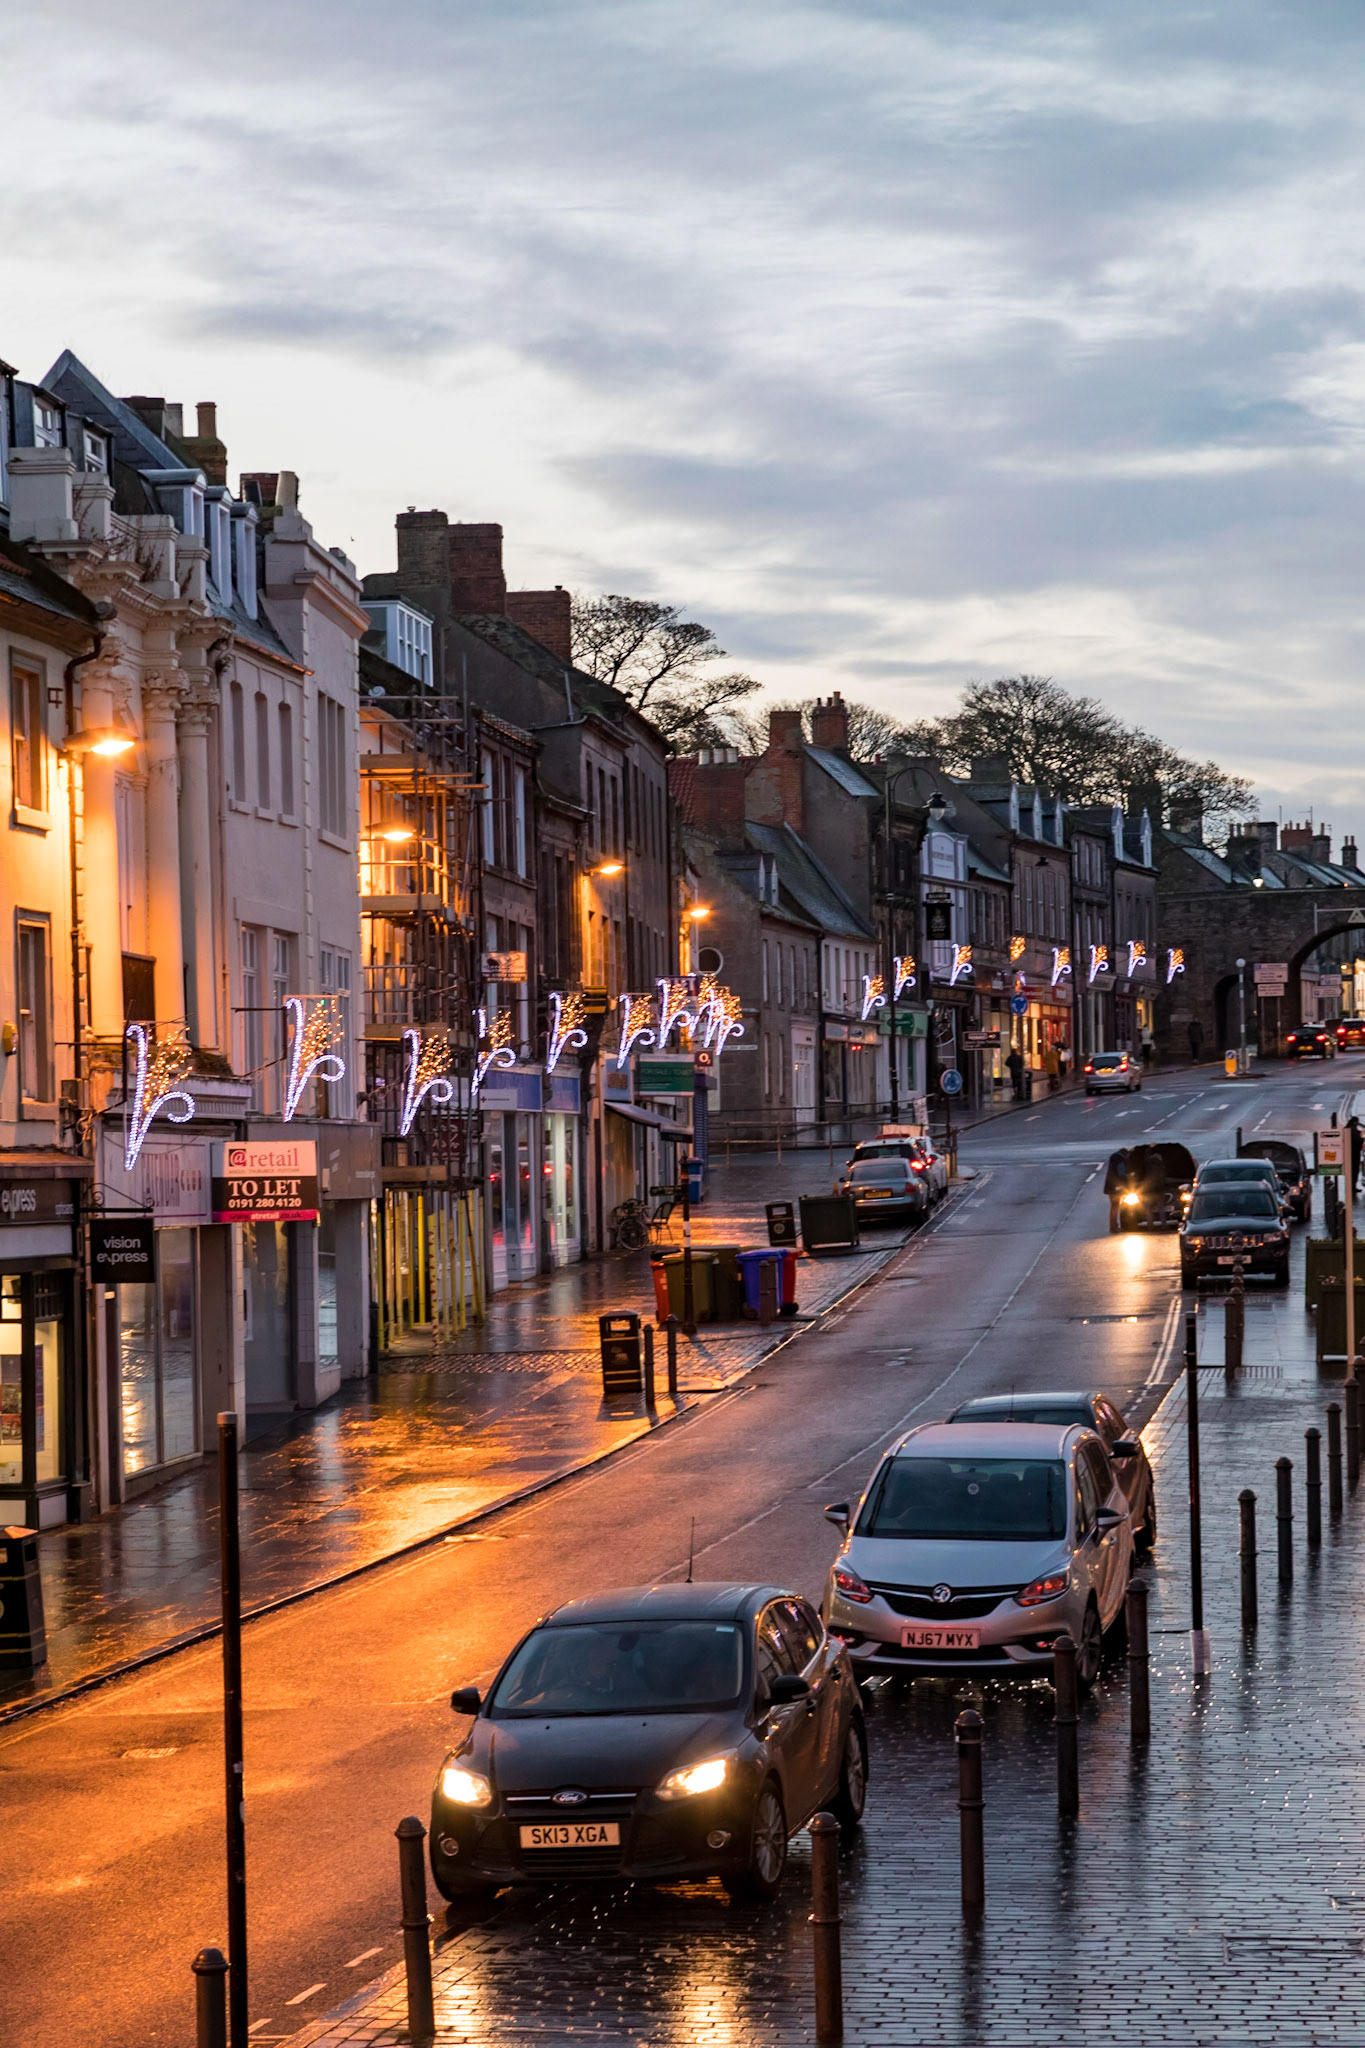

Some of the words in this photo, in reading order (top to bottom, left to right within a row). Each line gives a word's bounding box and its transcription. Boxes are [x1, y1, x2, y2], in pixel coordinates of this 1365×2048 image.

[228, 1180, 258, 1197] TO
[263, 1179, 301, 1196] LET
[228, 1198, 253, 1208] 0191
[255, 1198, 275, 1208] 280
[275, 1198, 302, 1207] 4120
[103, 1235, 141, 1249] vision
[907, 1632, 943, 1646] NJ67
[945, 1633, 973, 1647] MYX
[559, 1793, 580, 1802] Ford
[531, 1827, 570, 1844] SK13
[574, 1826, 609, 1843] XGA
